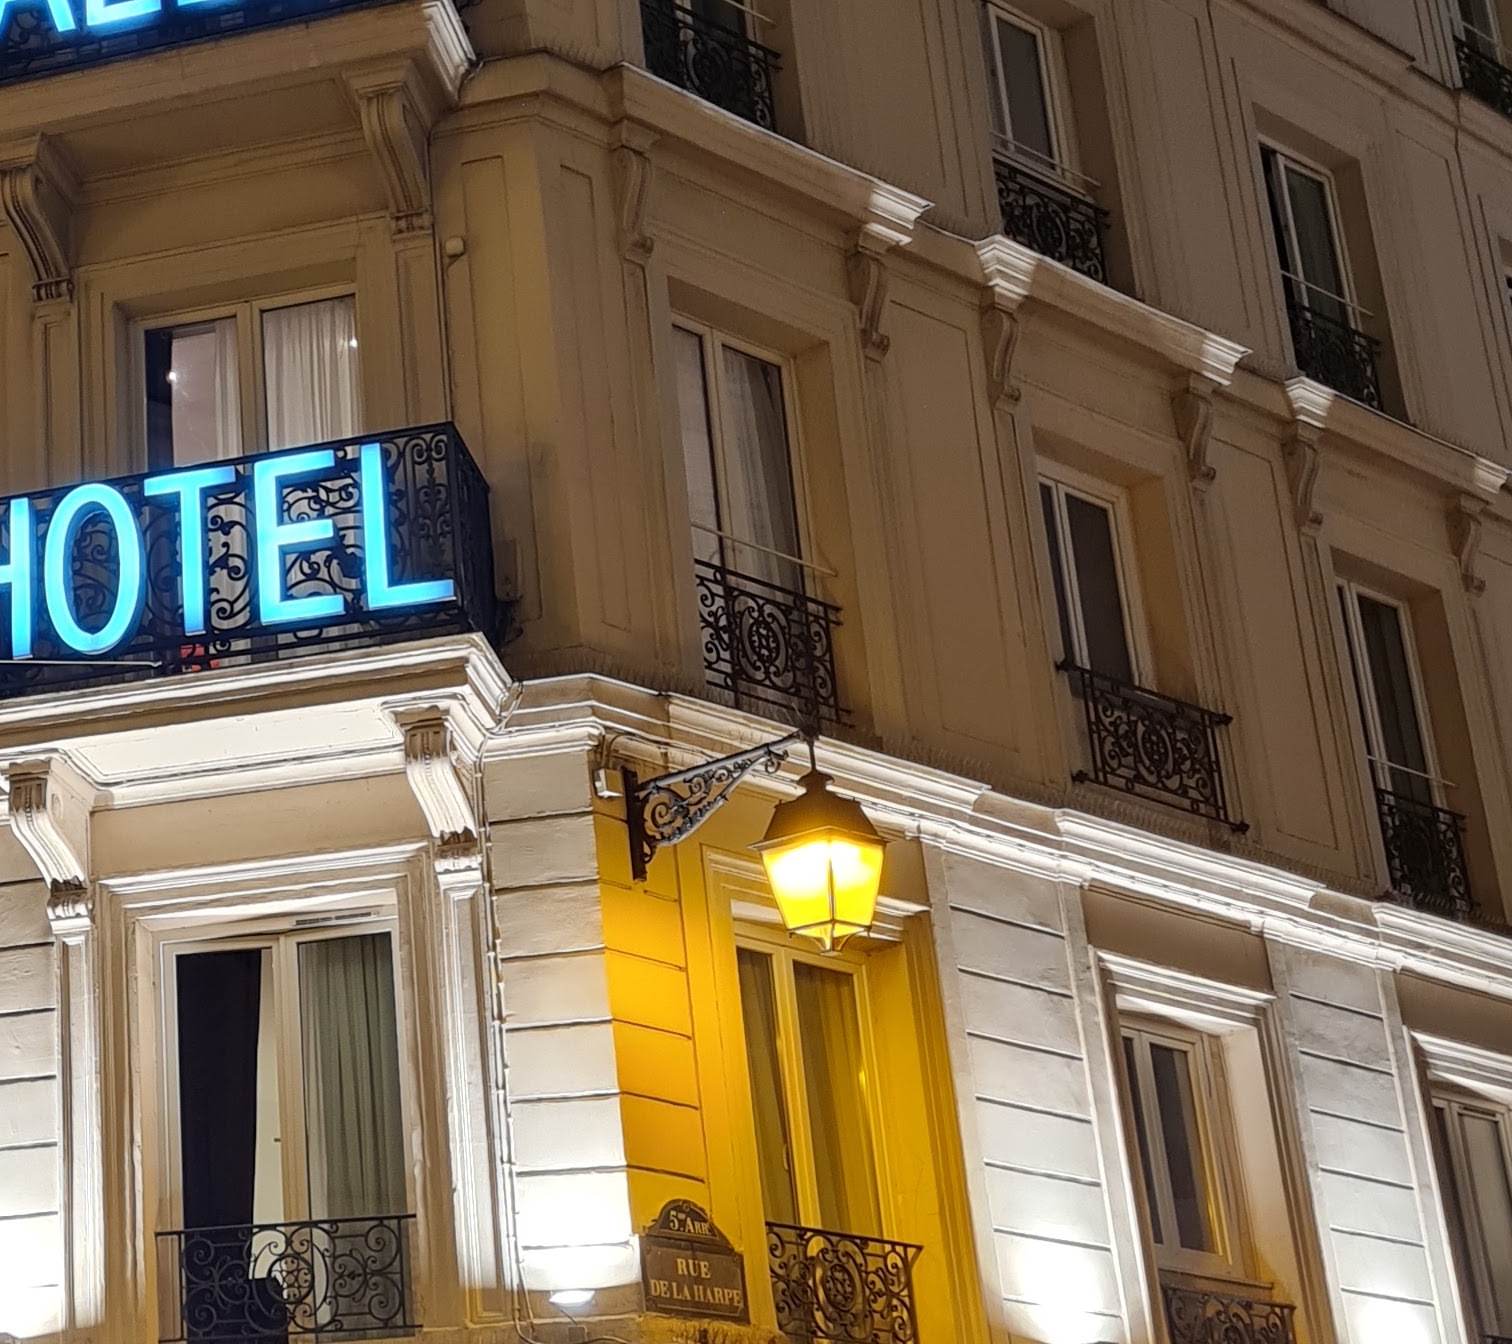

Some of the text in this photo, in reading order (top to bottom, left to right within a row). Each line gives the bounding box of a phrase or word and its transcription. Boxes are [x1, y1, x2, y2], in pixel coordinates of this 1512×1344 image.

[676, 1258, 711, 1279] RUE
[650, 1279, 744, 1306] DE LA HARPE
